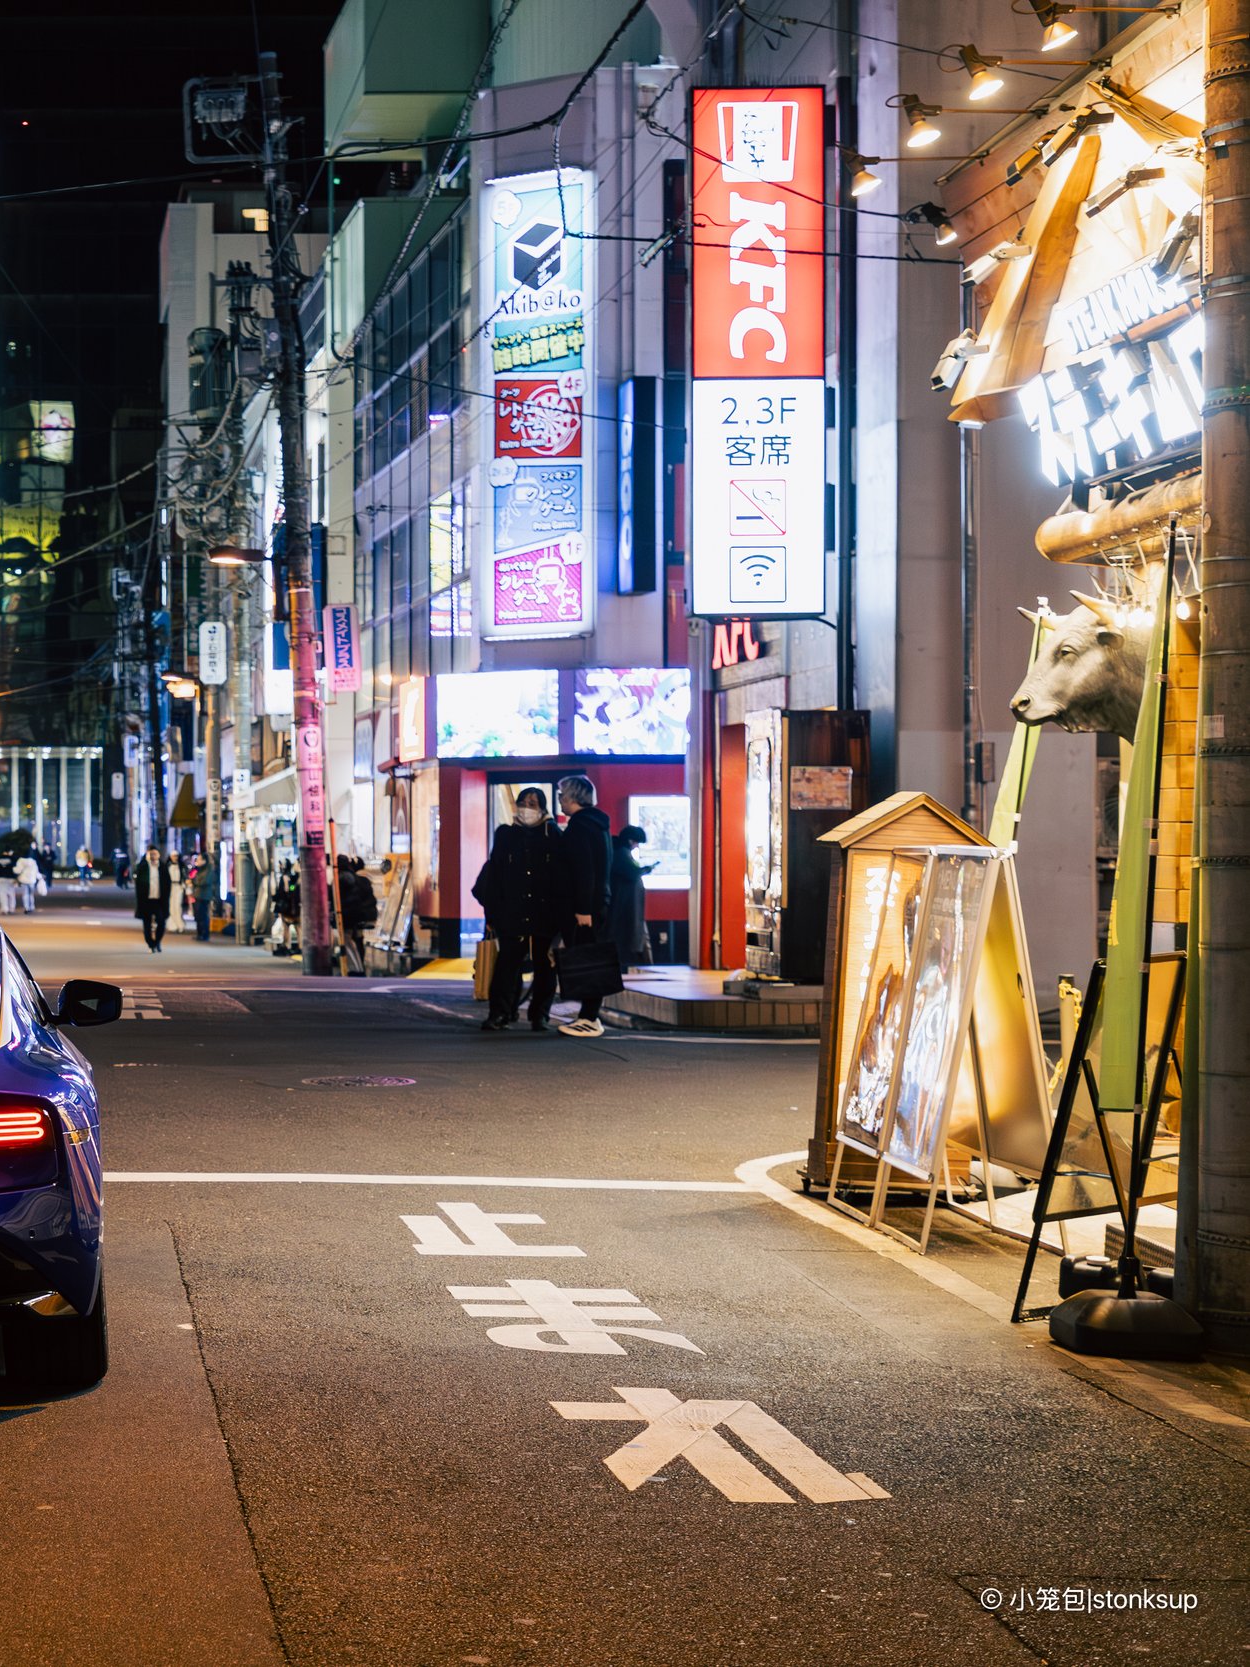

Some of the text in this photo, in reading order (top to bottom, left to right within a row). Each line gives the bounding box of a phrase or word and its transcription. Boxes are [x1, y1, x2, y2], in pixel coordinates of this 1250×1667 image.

[729, 192, 787, 363] KFC
[564, 377, 582, 391] 4F
[726, 435, 792, 466] 客席
